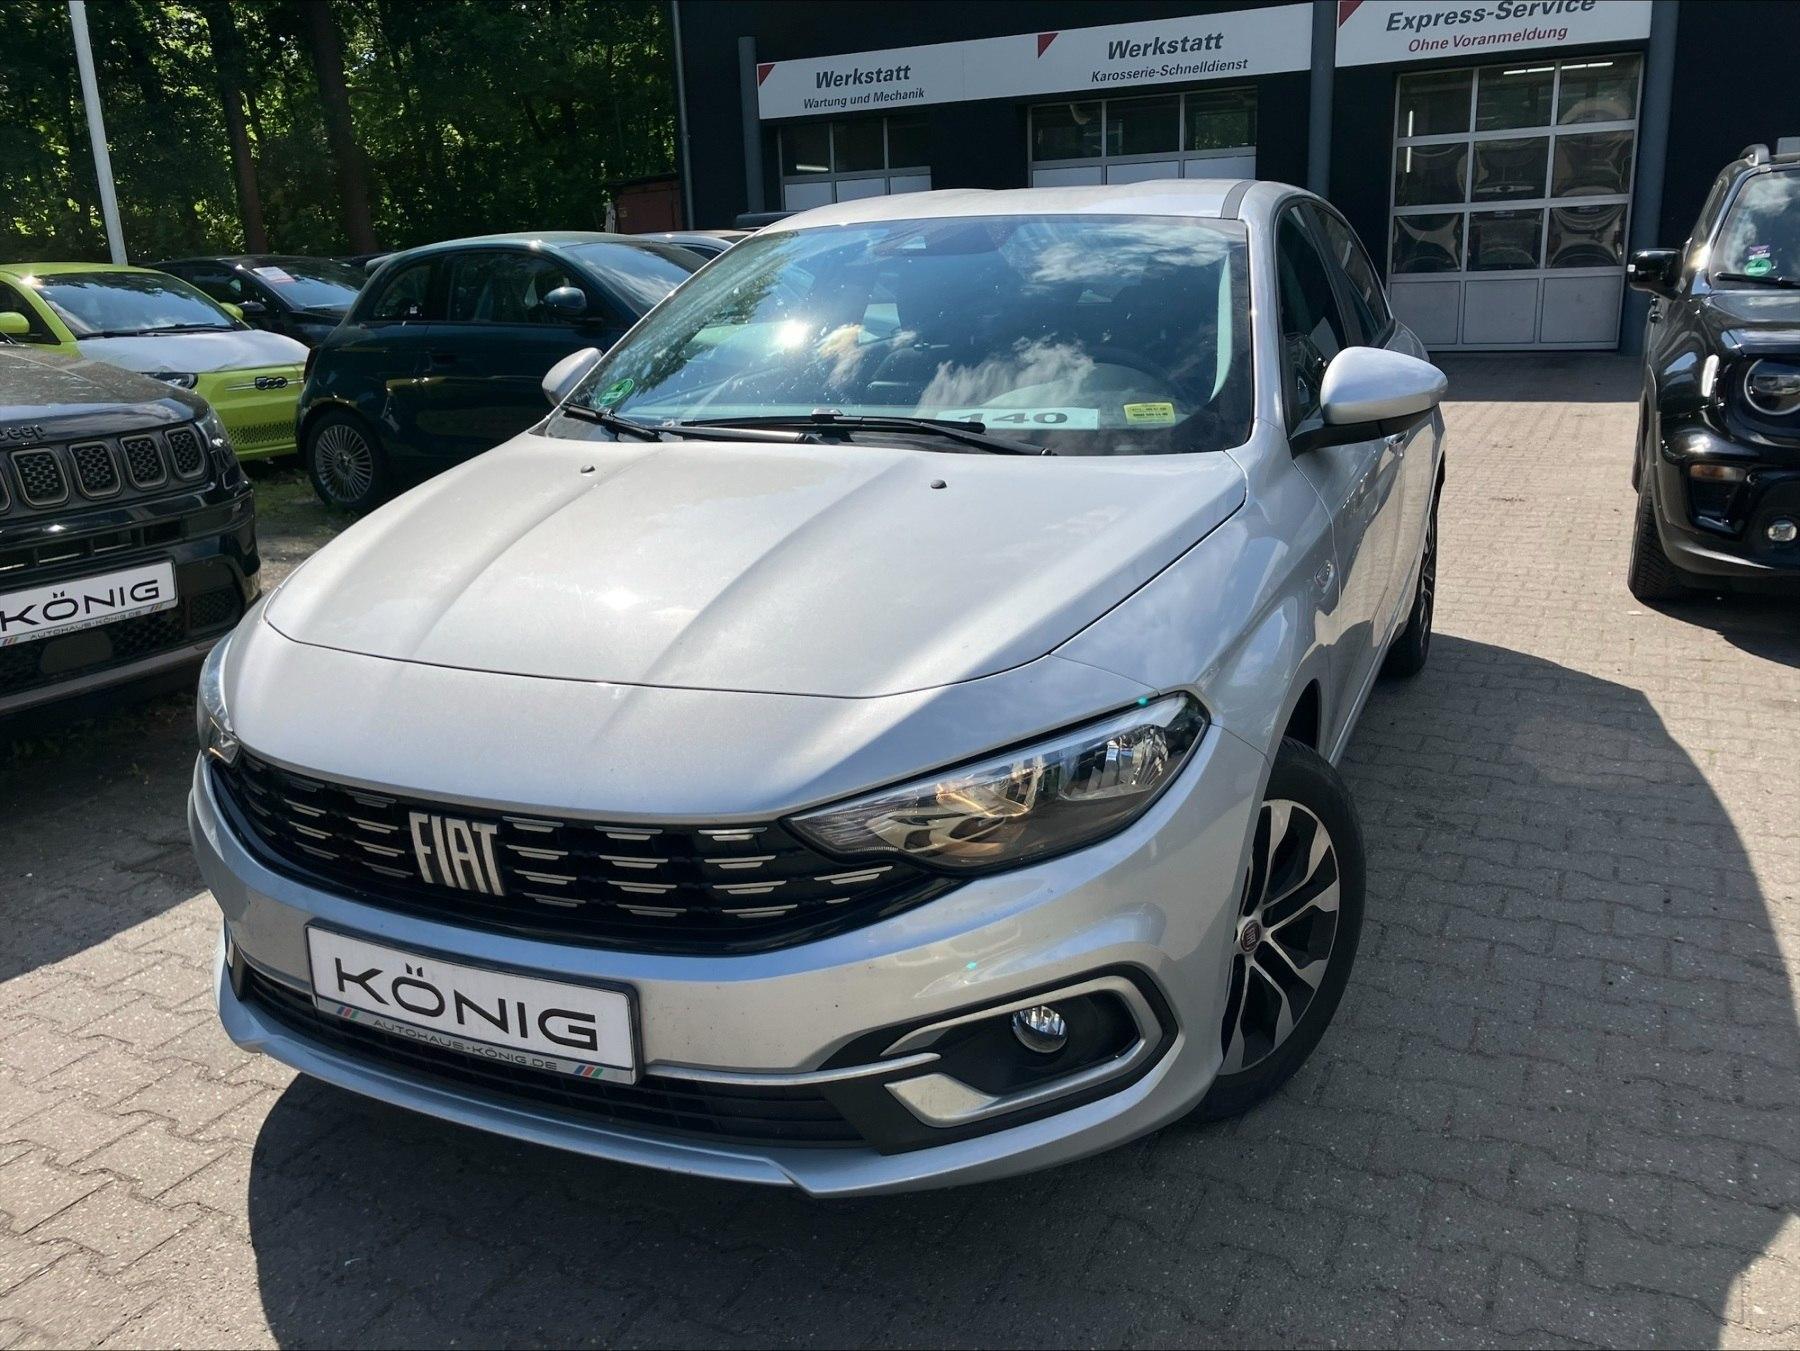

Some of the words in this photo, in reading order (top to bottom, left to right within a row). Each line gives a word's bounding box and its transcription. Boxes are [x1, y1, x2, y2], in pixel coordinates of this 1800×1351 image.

[1386, 0, 1596, 33] Express-Service
[1108, 32, 1224, 60] Werkstatt
[1408, 38, 1449, 52] Ohne
[1453, 27, 1568, 47] Voranmeldung
[816, 65, 912, 88] Werkstatt
[1091, 58, 1249, 82] Karosserie-Schnelldienst
[803, 97, 848, 109] Wartung
[850, 93, 870, 105] und
[873, 87, 925, 103] Mechanik
[958, 412, 1068, 424] 140
[0, 579, 160, 632] KÖNIG
[409, 811, 504, 897] FIAT
[335, 957, 598, 1052] KÖNIG
